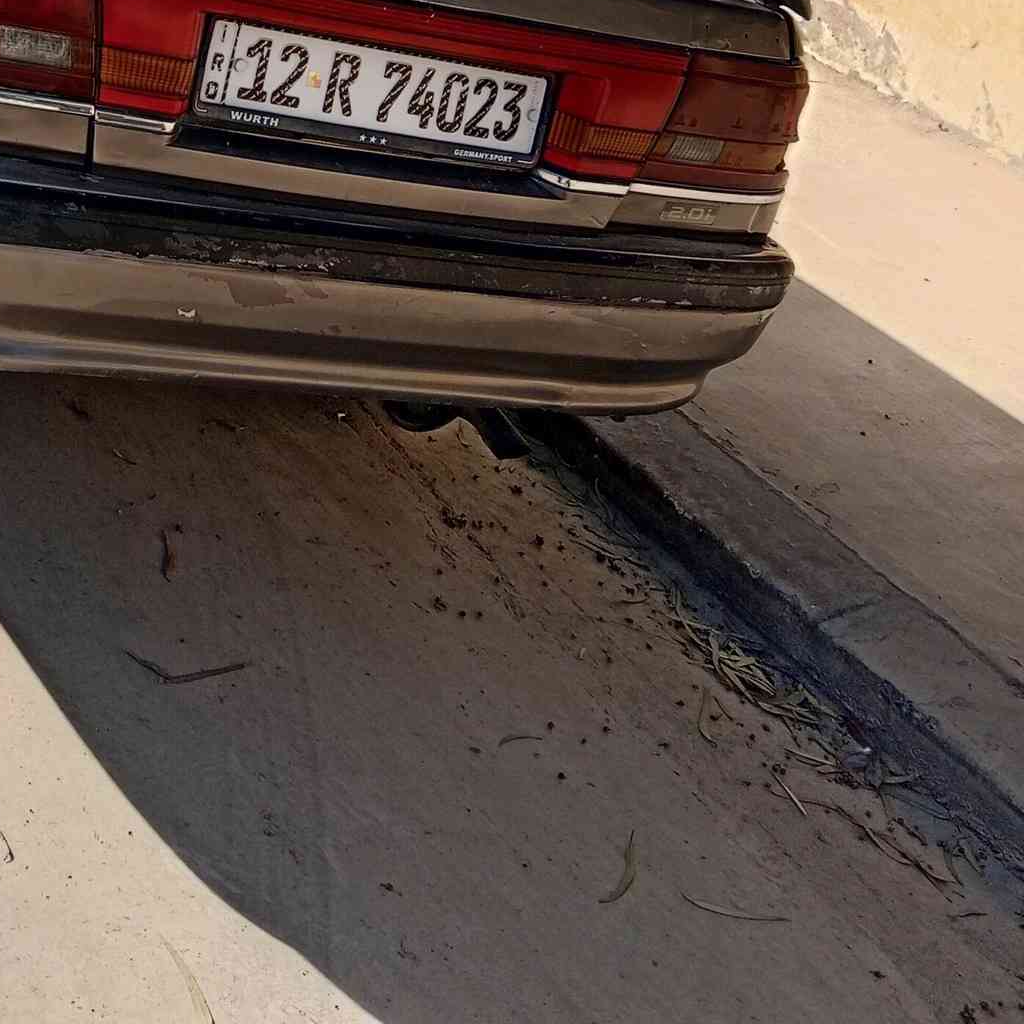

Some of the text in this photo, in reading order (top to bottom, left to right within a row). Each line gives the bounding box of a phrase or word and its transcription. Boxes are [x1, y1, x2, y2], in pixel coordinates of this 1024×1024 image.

[237, 38, 309, 109] 12
[322, 50, 362, 117] R
[376, 61, 528, 142] 74023
